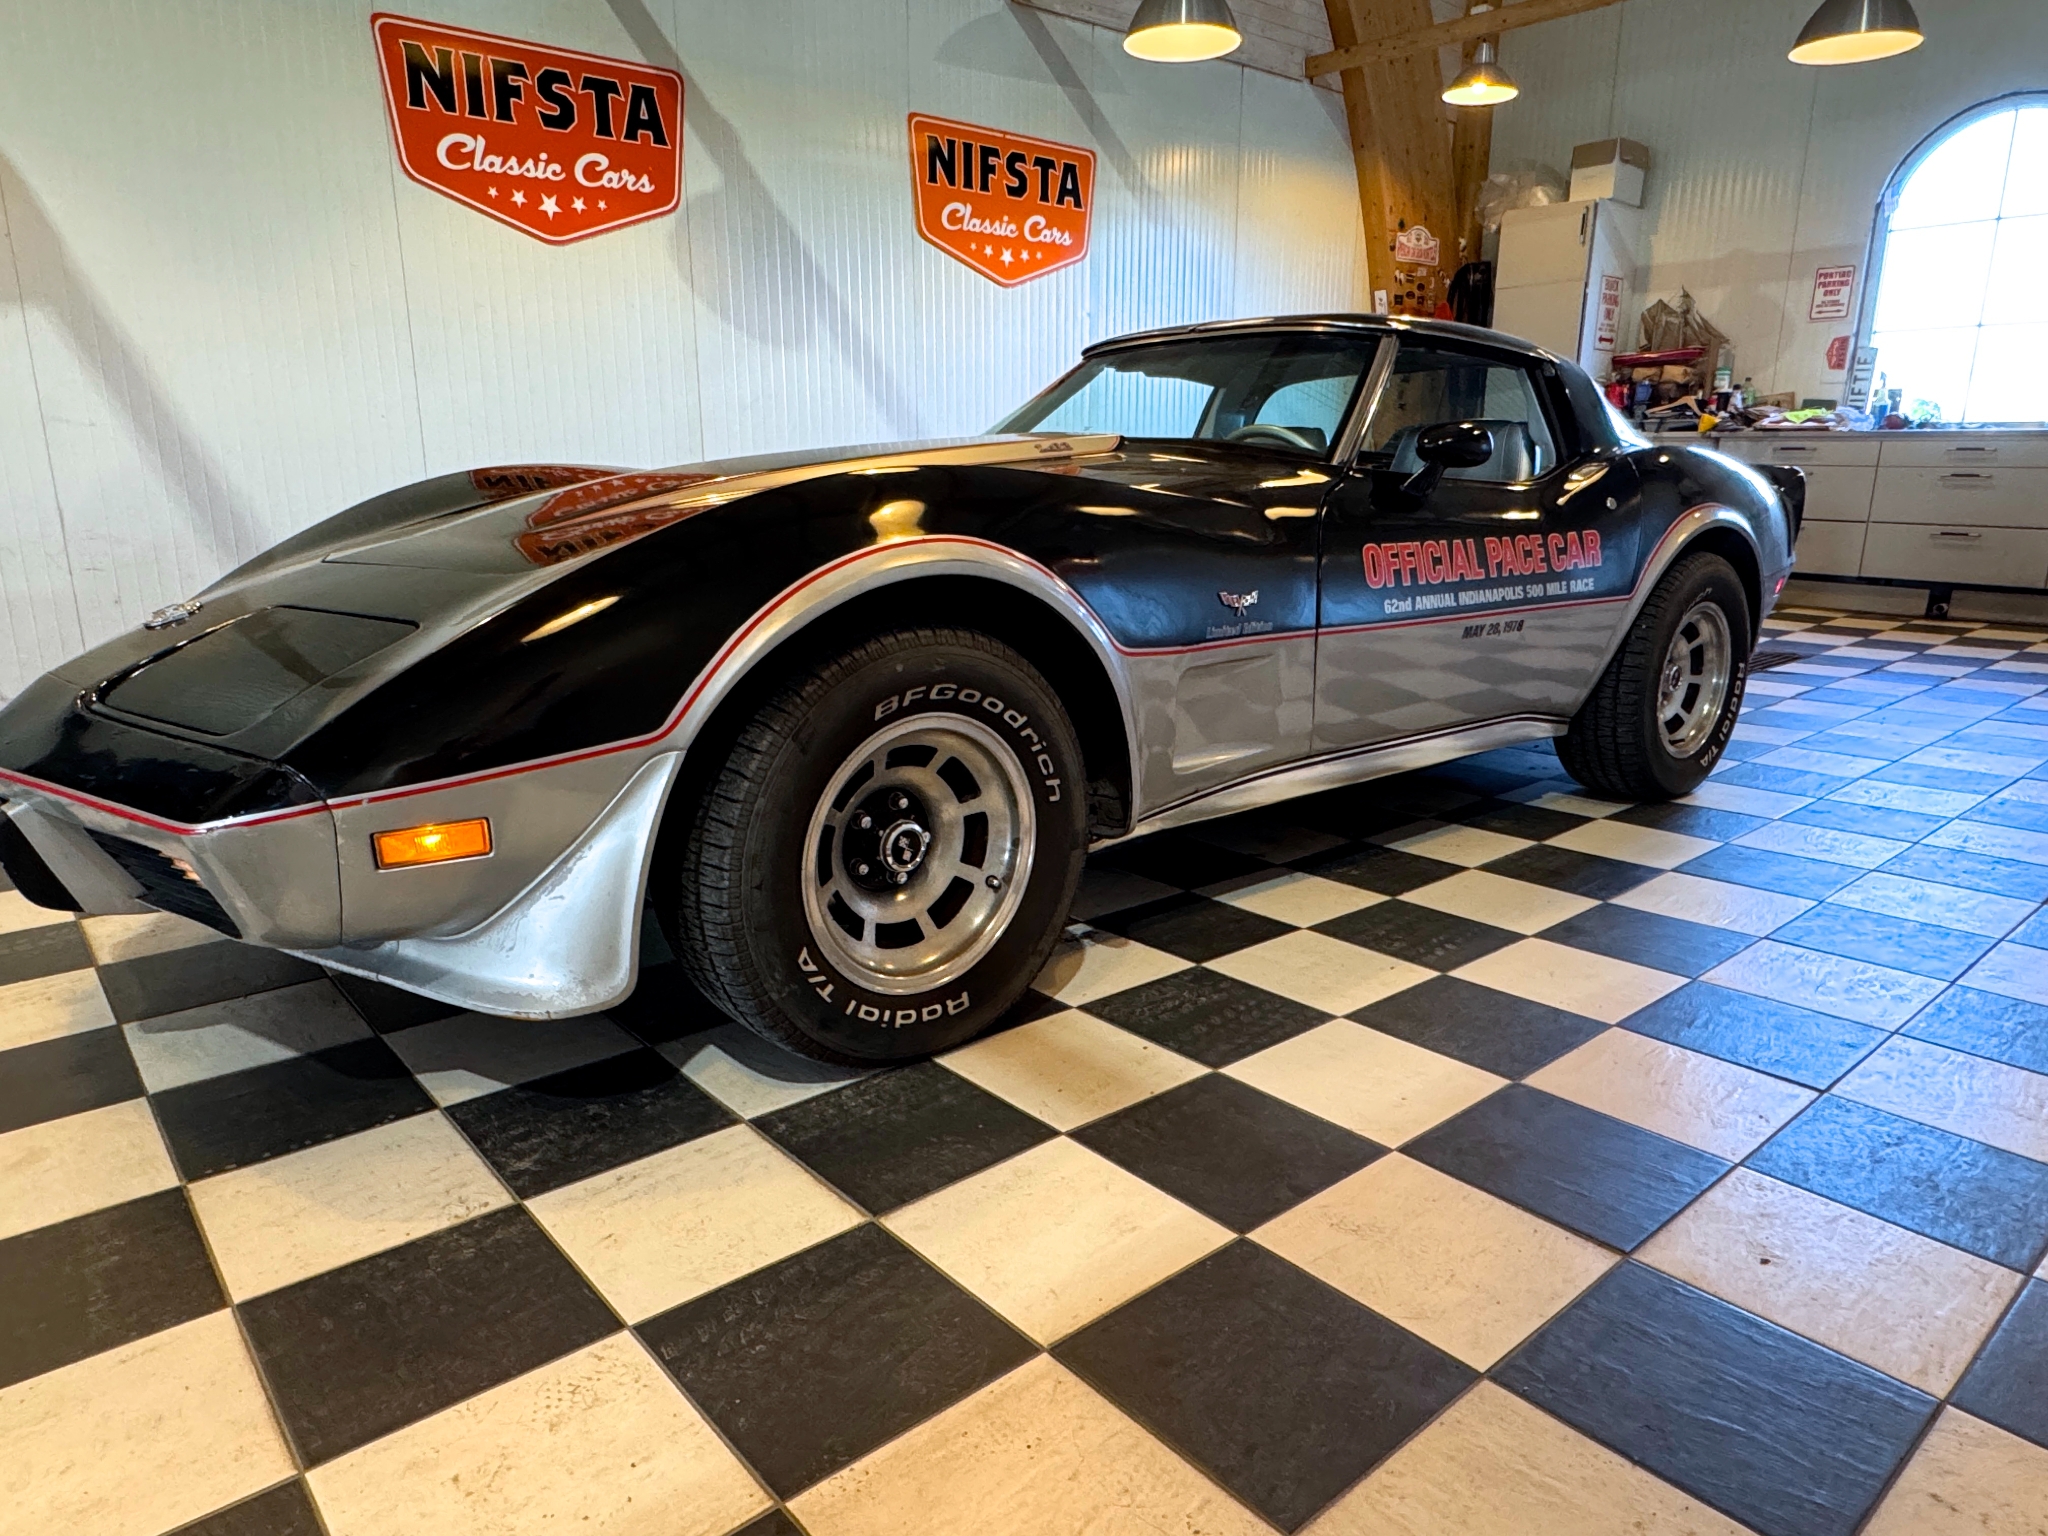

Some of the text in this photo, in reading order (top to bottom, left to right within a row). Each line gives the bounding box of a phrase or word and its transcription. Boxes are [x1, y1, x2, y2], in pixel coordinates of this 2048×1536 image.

[399, 39, 671, 149] NIFSTA
[436, 133, 655, 193] Classic Cars
[925, 133, 1085, 211] NIFSTA
[941, 202, 1073, 246] Classic Cars
[1818, 279, 1850, 289] PARKING
[1823, 289, 1841, 297] ONLY
[1362, 530, 1602, 589] OFFICIAL PACE CAR
[1384, 578, 1595, 614] 62nd ANNUAL INDIANAPOLIS 500 MILE RACE
[1462, 624, 1486, 639] MAY
[874, 683, 1062, 802] BFGoodrich
[1700, 662, 1745, 767] Radial T/A
[798, 946, 971, 1029] Radial T/A
